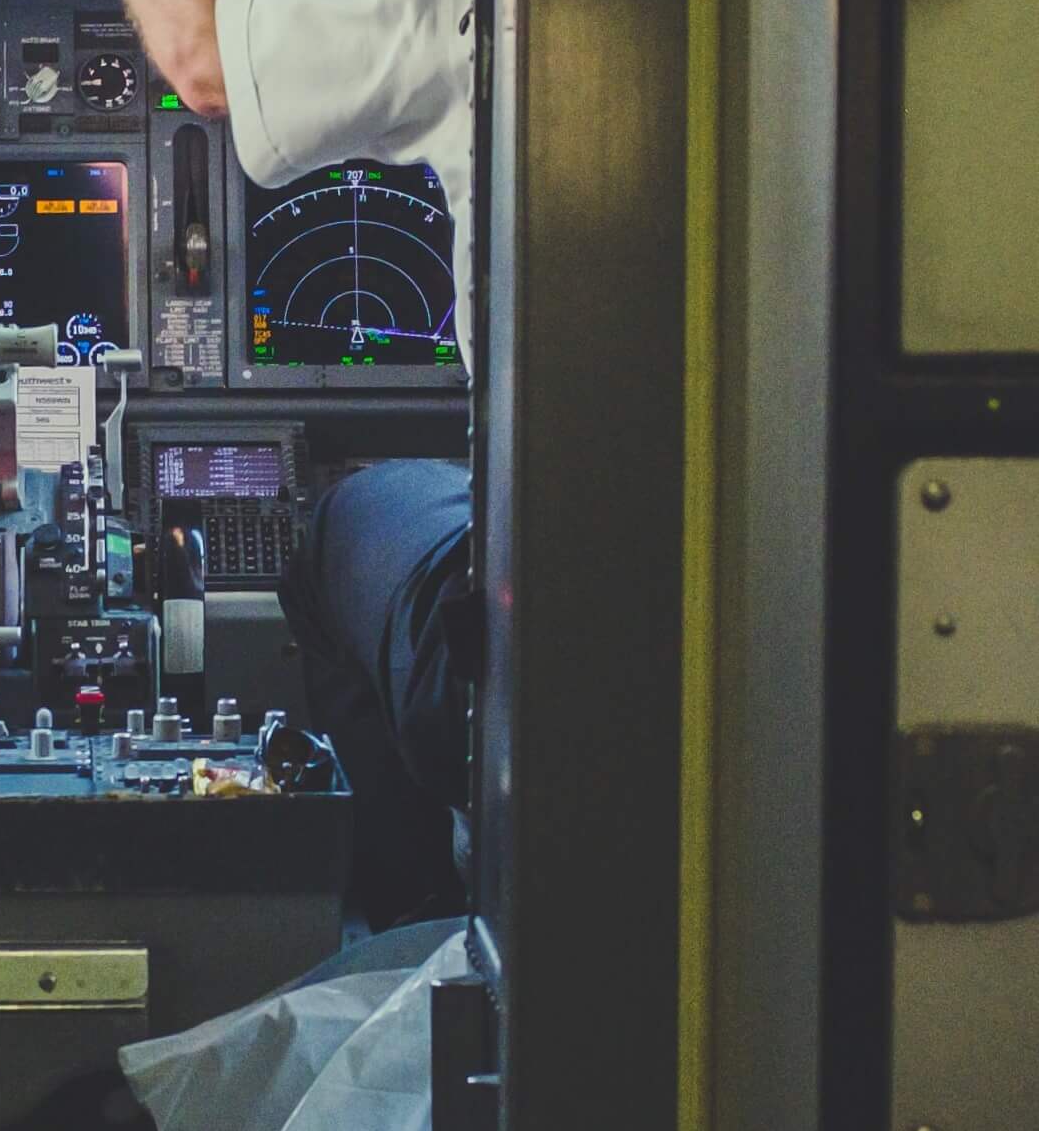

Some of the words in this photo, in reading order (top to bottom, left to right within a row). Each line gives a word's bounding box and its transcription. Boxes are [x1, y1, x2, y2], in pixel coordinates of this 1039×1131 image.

[347, 171, 363, 180] 207
[10, 186, 29, 197] 0.0
[18, 377, 65, 385] uthwest
[67, 512, 81, 520] 25
[65, 534, 81, 542] 30
[65, 564, 81, 573] 40
